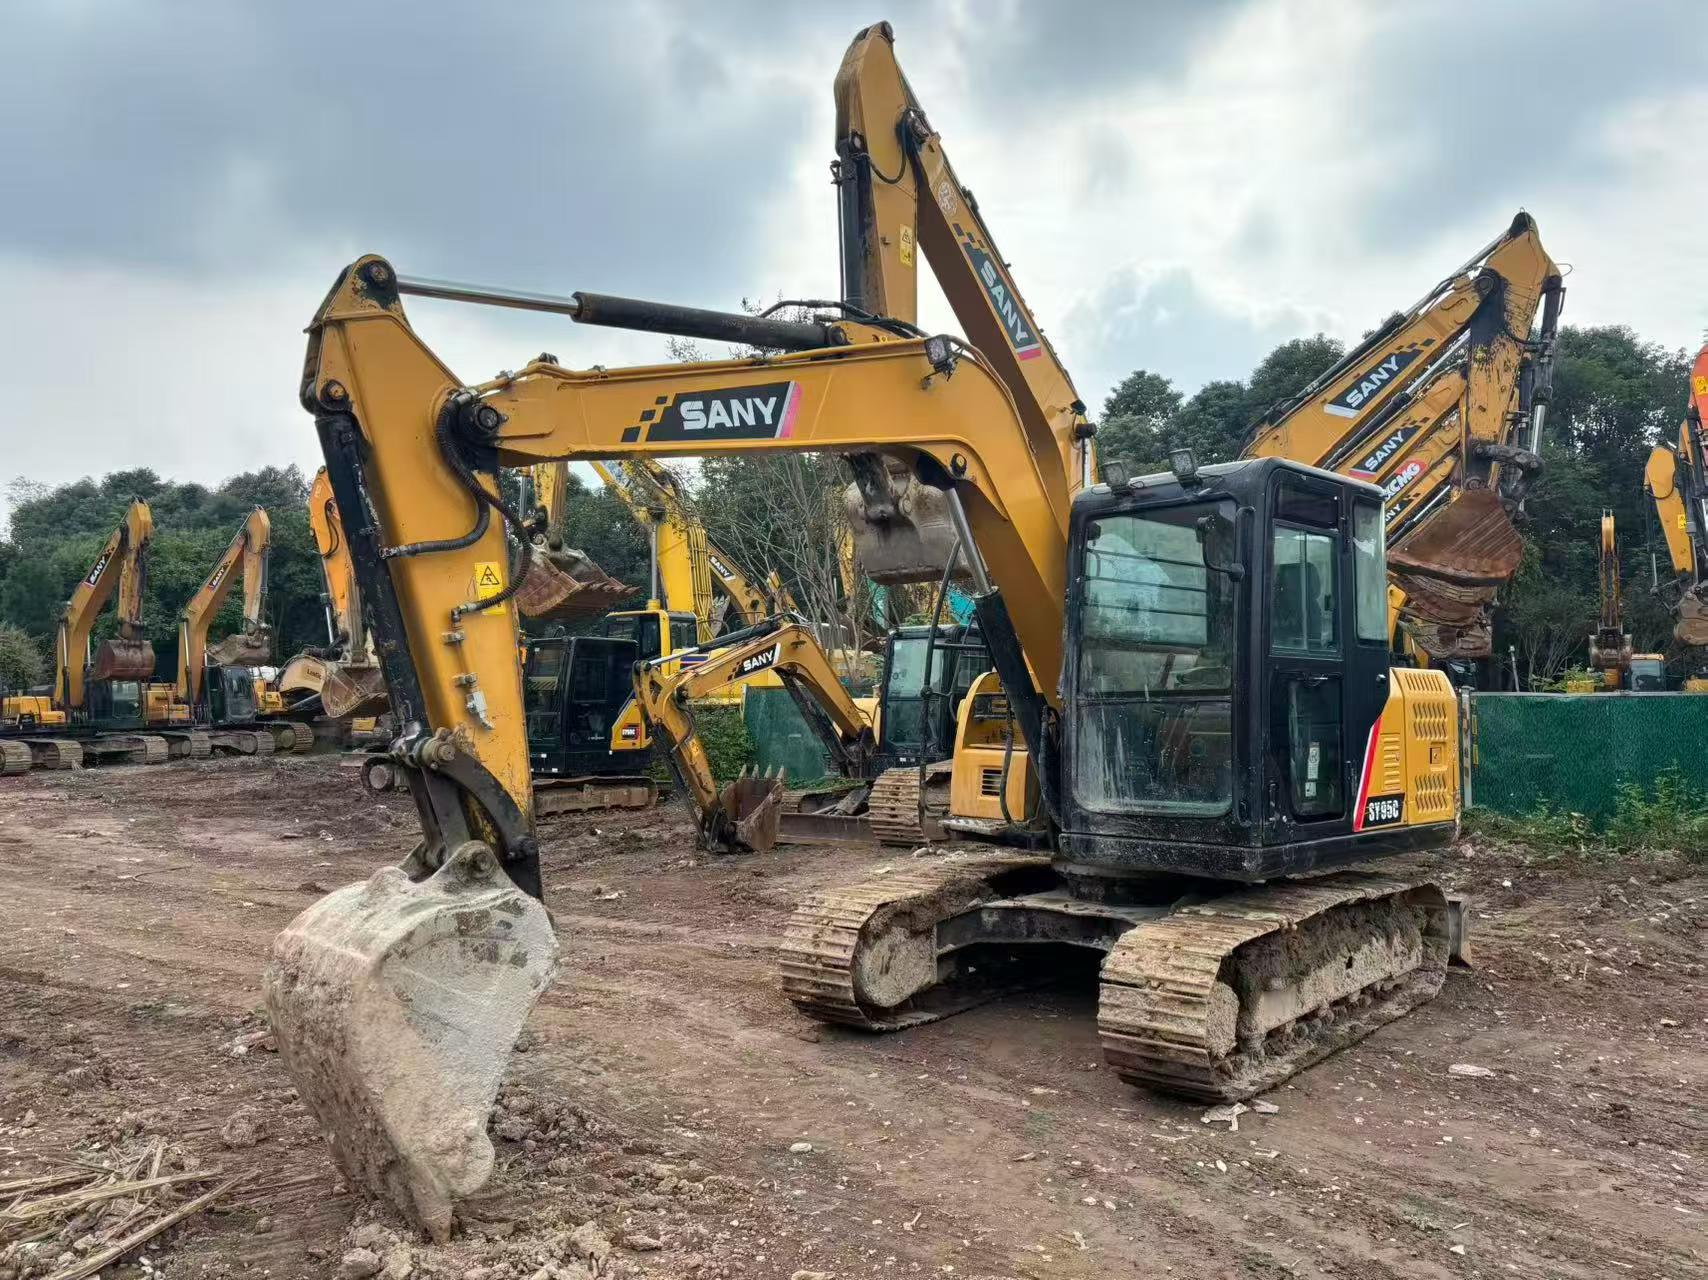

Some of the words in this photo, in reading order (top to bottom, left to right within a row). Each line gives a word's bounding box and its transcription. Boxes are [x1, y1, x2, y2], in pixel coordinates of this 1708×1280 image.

[980, 260, 1028, 342] SANY
[1346, 355, 1399, 408] SANY
[680, 397, 777, 430] SANY
[1365, 430, 1404, 471] SANY
[1383, 462, 1420, 501] XCMG
[90, 556, 106, 584] SANY
[743, 650, 774, 671] SANY
[1368, 800, 1399, 821] SY95C
